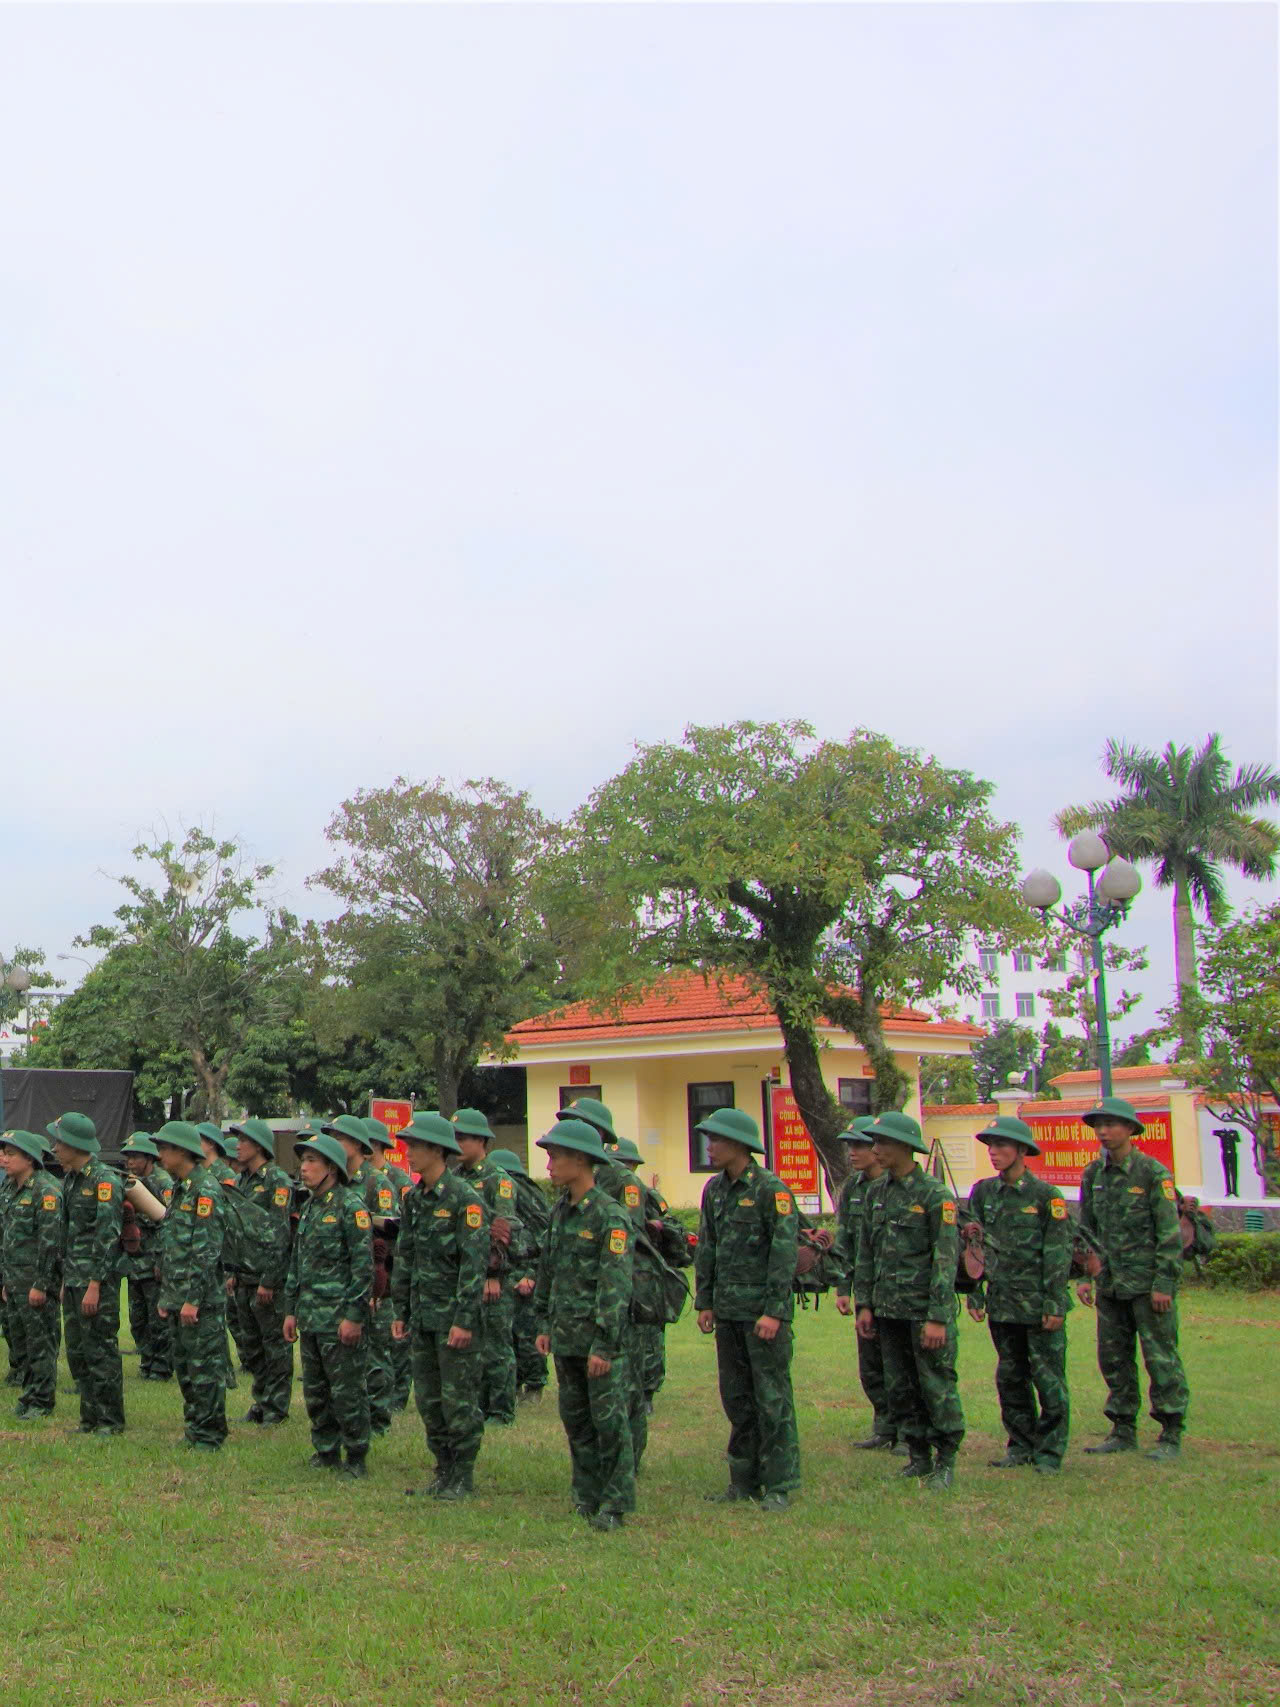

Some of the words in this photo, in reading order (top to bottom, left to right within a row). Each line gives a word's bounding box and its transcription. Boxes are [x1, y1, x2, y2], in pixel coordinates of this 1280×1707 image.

[1055, 1120, 1070, 1141] BẢO
[1070, 1121, 1080, 1144] VỆ
[781, 1155, 794, 1166] VIỆT
[795, 1155, 809, 1165] NAM
[1045, 1151, 1055, 1167] AN
[1056, 1151, 1073, 1167] NINH
